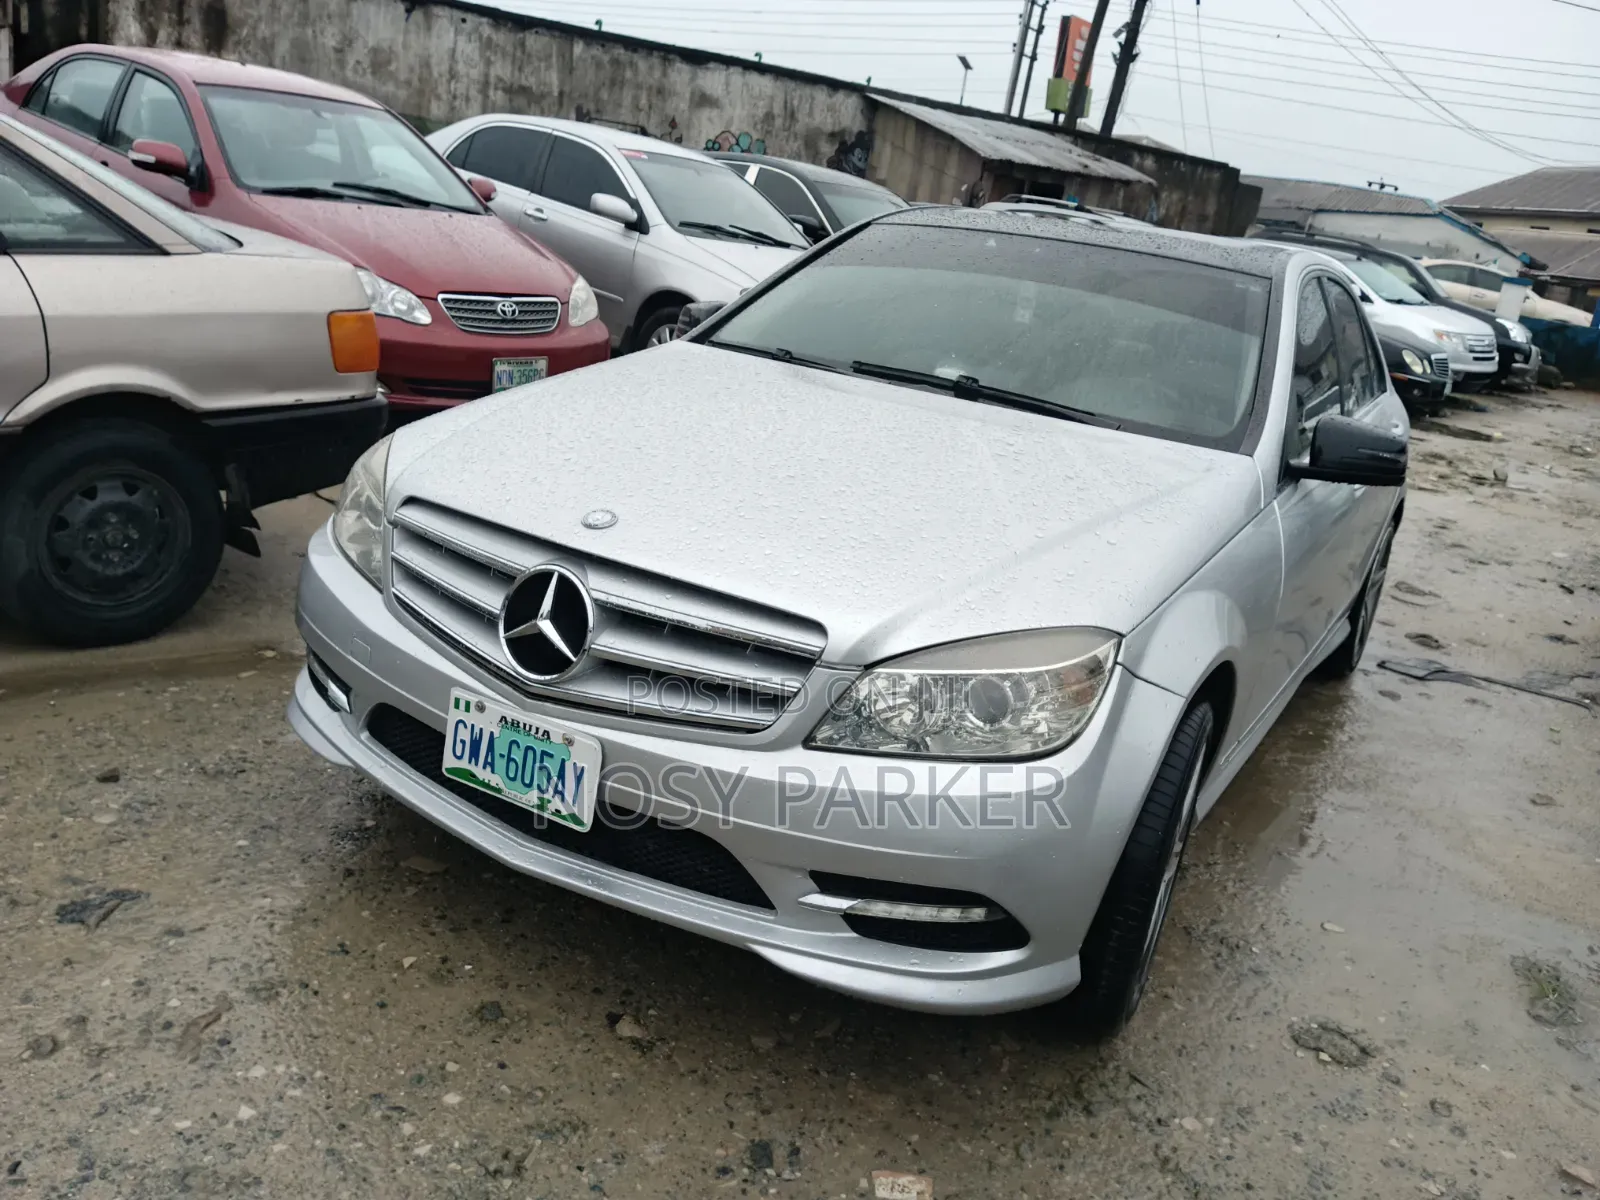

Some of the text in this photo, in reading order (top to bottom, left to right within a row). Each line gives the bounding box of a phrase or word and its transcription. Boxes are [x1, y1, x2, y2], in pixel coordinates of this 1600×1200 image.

[496, 722, 522, 736] CENTRE
[498, 715, 552, 741] ABUJA
[452, 718, 585, 807] GWA-605AY
